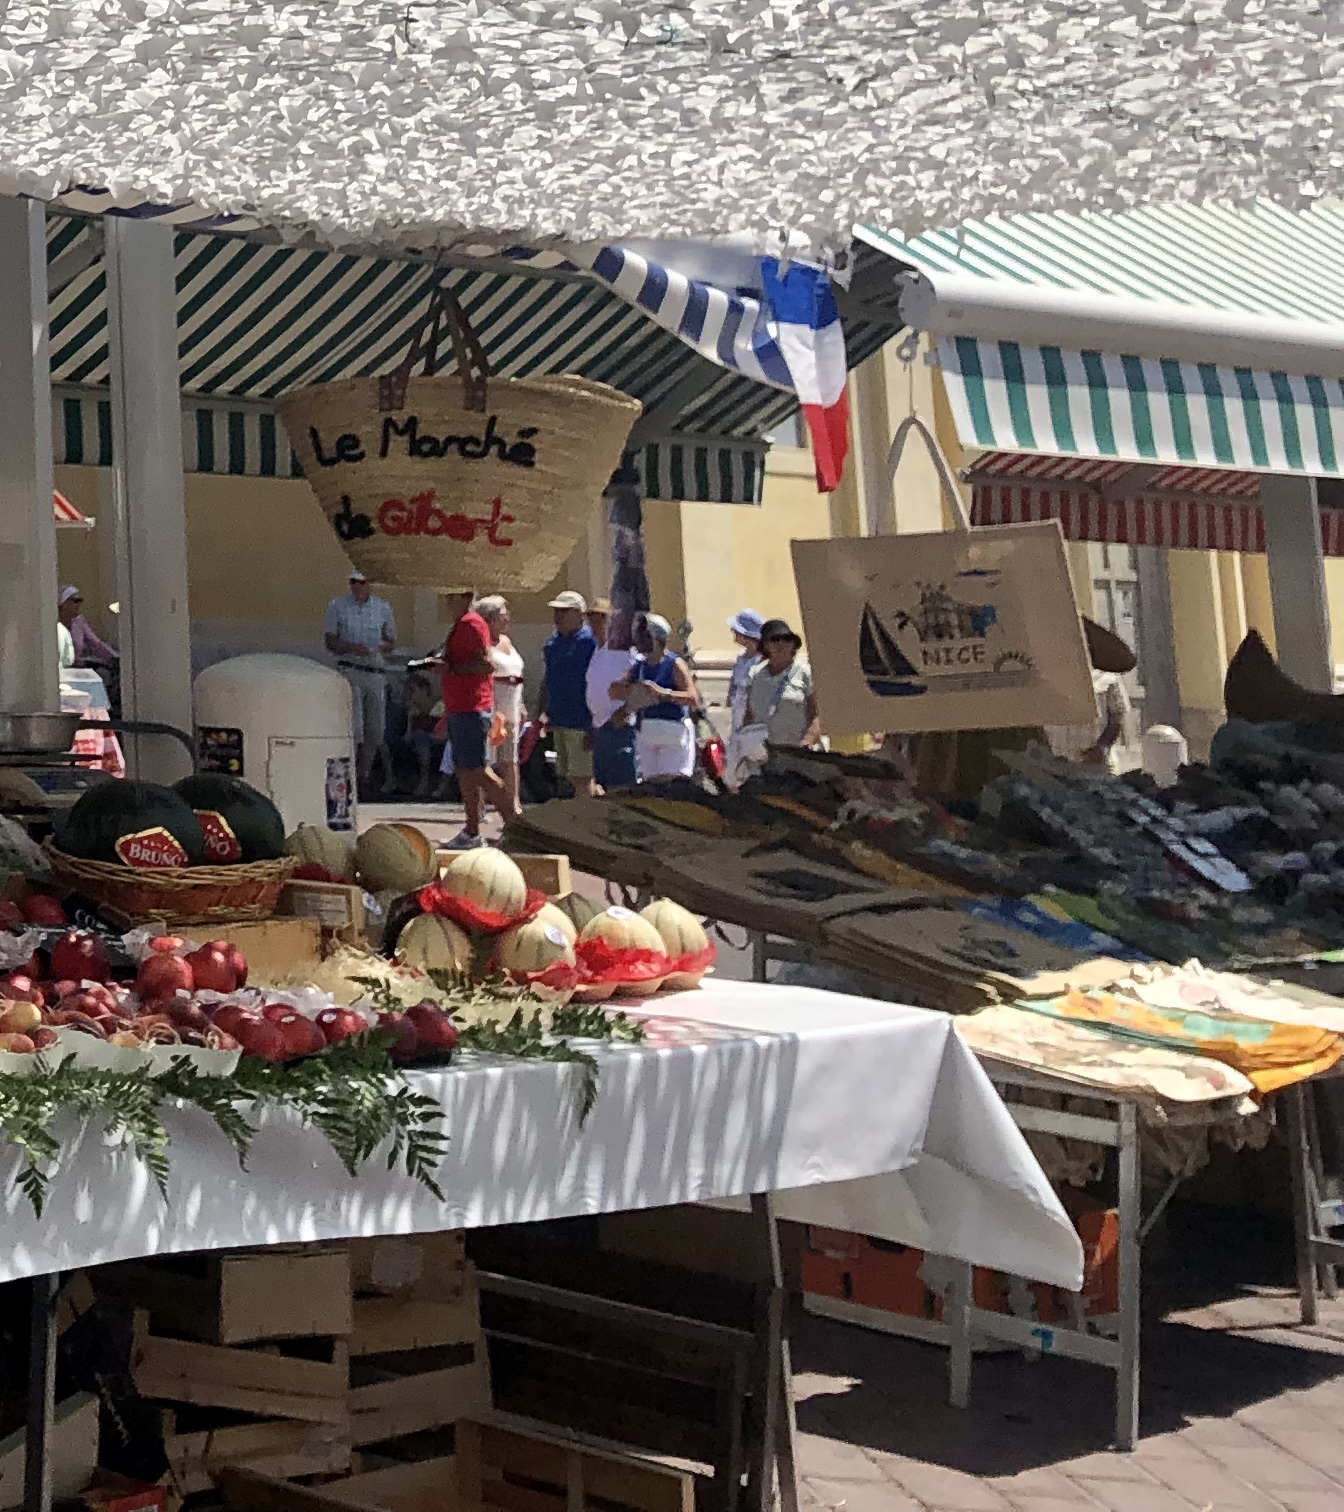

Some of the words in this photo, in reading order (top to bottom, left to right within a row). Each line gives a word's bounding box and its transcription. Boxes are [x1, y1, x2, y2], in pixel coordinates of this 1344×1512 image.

[308, 425, 366, 467] Le
[379, 414, 541, 468] Marché
[333, 495, 376, 541] de
[378, 487, 515, 547] Gilbert
[921, 643, 987, 667] NICE
